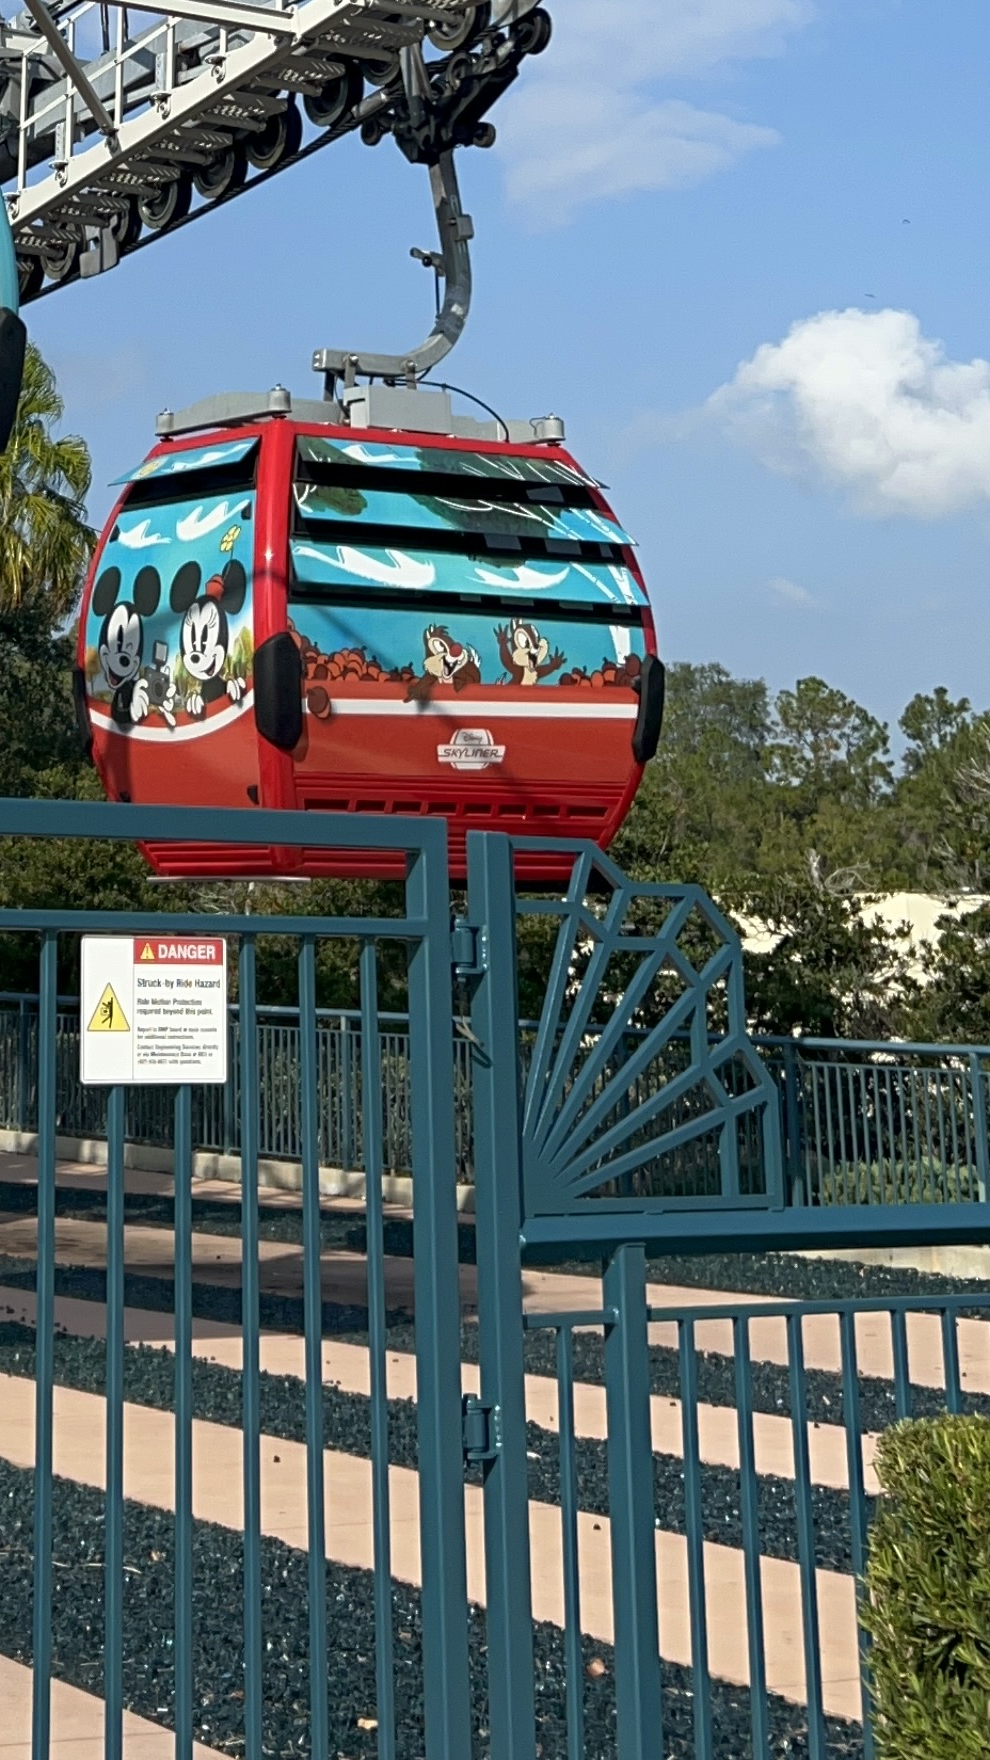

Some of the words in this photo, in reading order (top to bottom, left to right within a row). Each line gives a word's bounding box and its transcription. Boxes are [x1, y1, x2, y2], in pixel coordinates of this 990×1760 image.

[443, 747, 500, 759] SKYLINER
[158, 944, 216, 960] DANGER
[137, 978, 174, 989] Struck-by
[176, 978, 192, 988] Ride
[194, 978, 221, 988] Hazard
